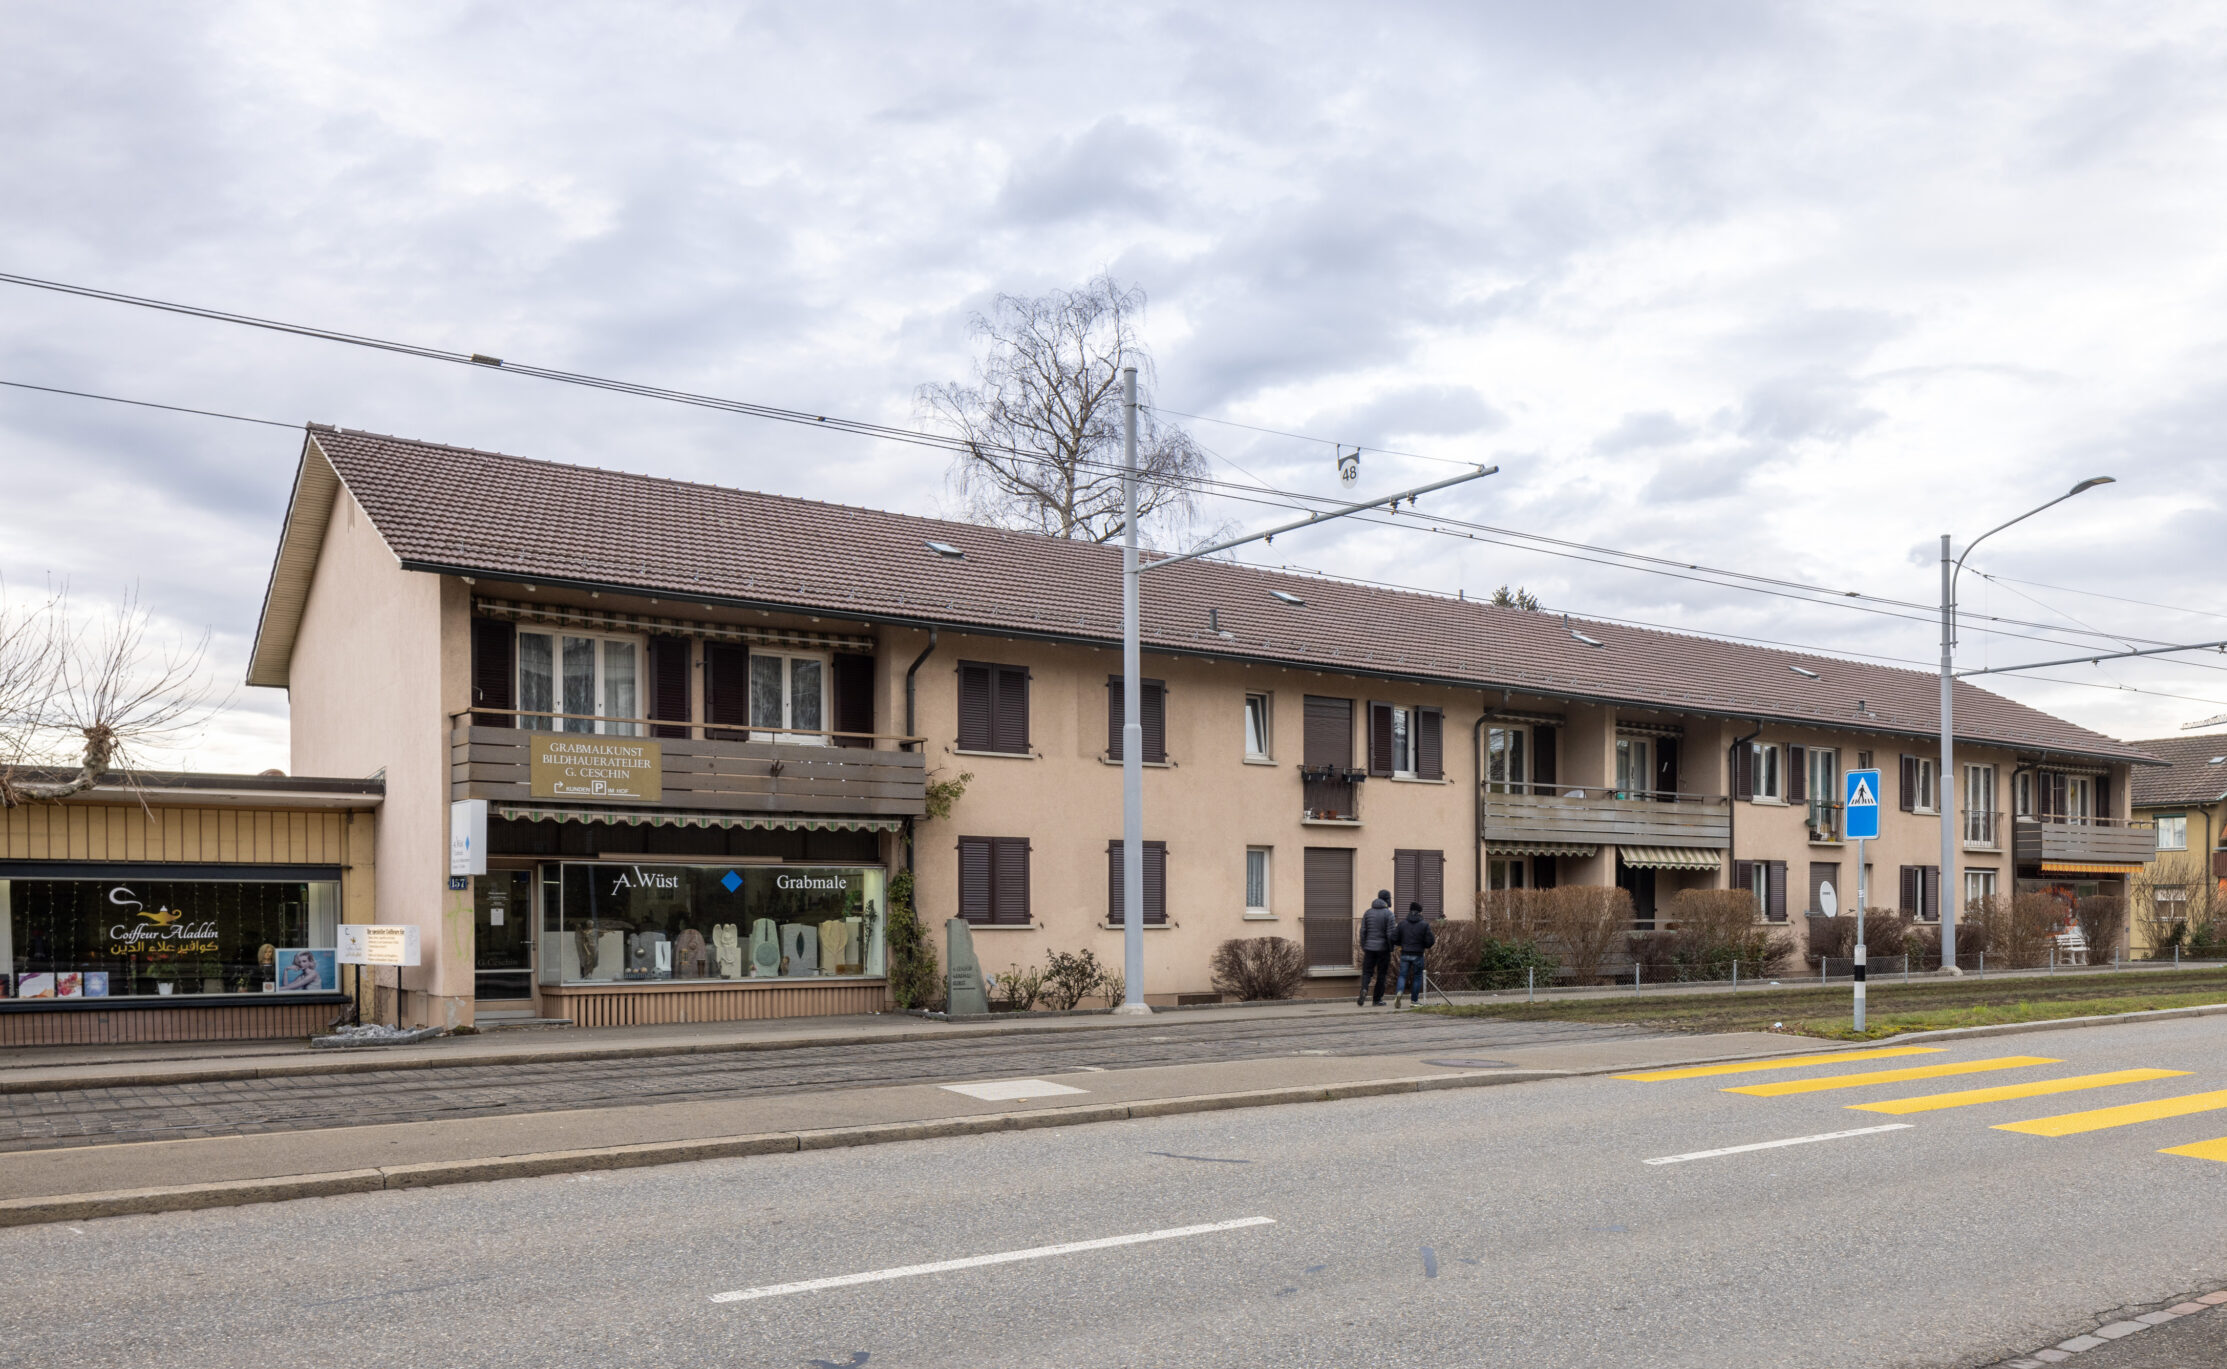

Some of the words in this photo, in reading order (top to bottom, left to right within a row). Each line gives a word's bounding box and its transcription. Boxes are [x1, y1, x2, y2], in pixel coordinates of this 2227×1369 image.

[1342, 465, 1357, 481] 48
[549, 742, 645, 757] GRABMALKUNST
[542, 754, 652, 769] BILDHAUERATELIER
[565, 767, 577, 777] G.
[580, 767, 630, 779] CESCHIN
[451, 878, 466, 888] 157
[776, 874, 847, 889] Grabmale
[110, 923, 160, 944] Coiffeur
[161, 921, 219, 939] Aladdin
[110, 940, 145, 955] الدين
[148, 940, 176, 952] علاء
[177, 940, 219, 954] كوافير
